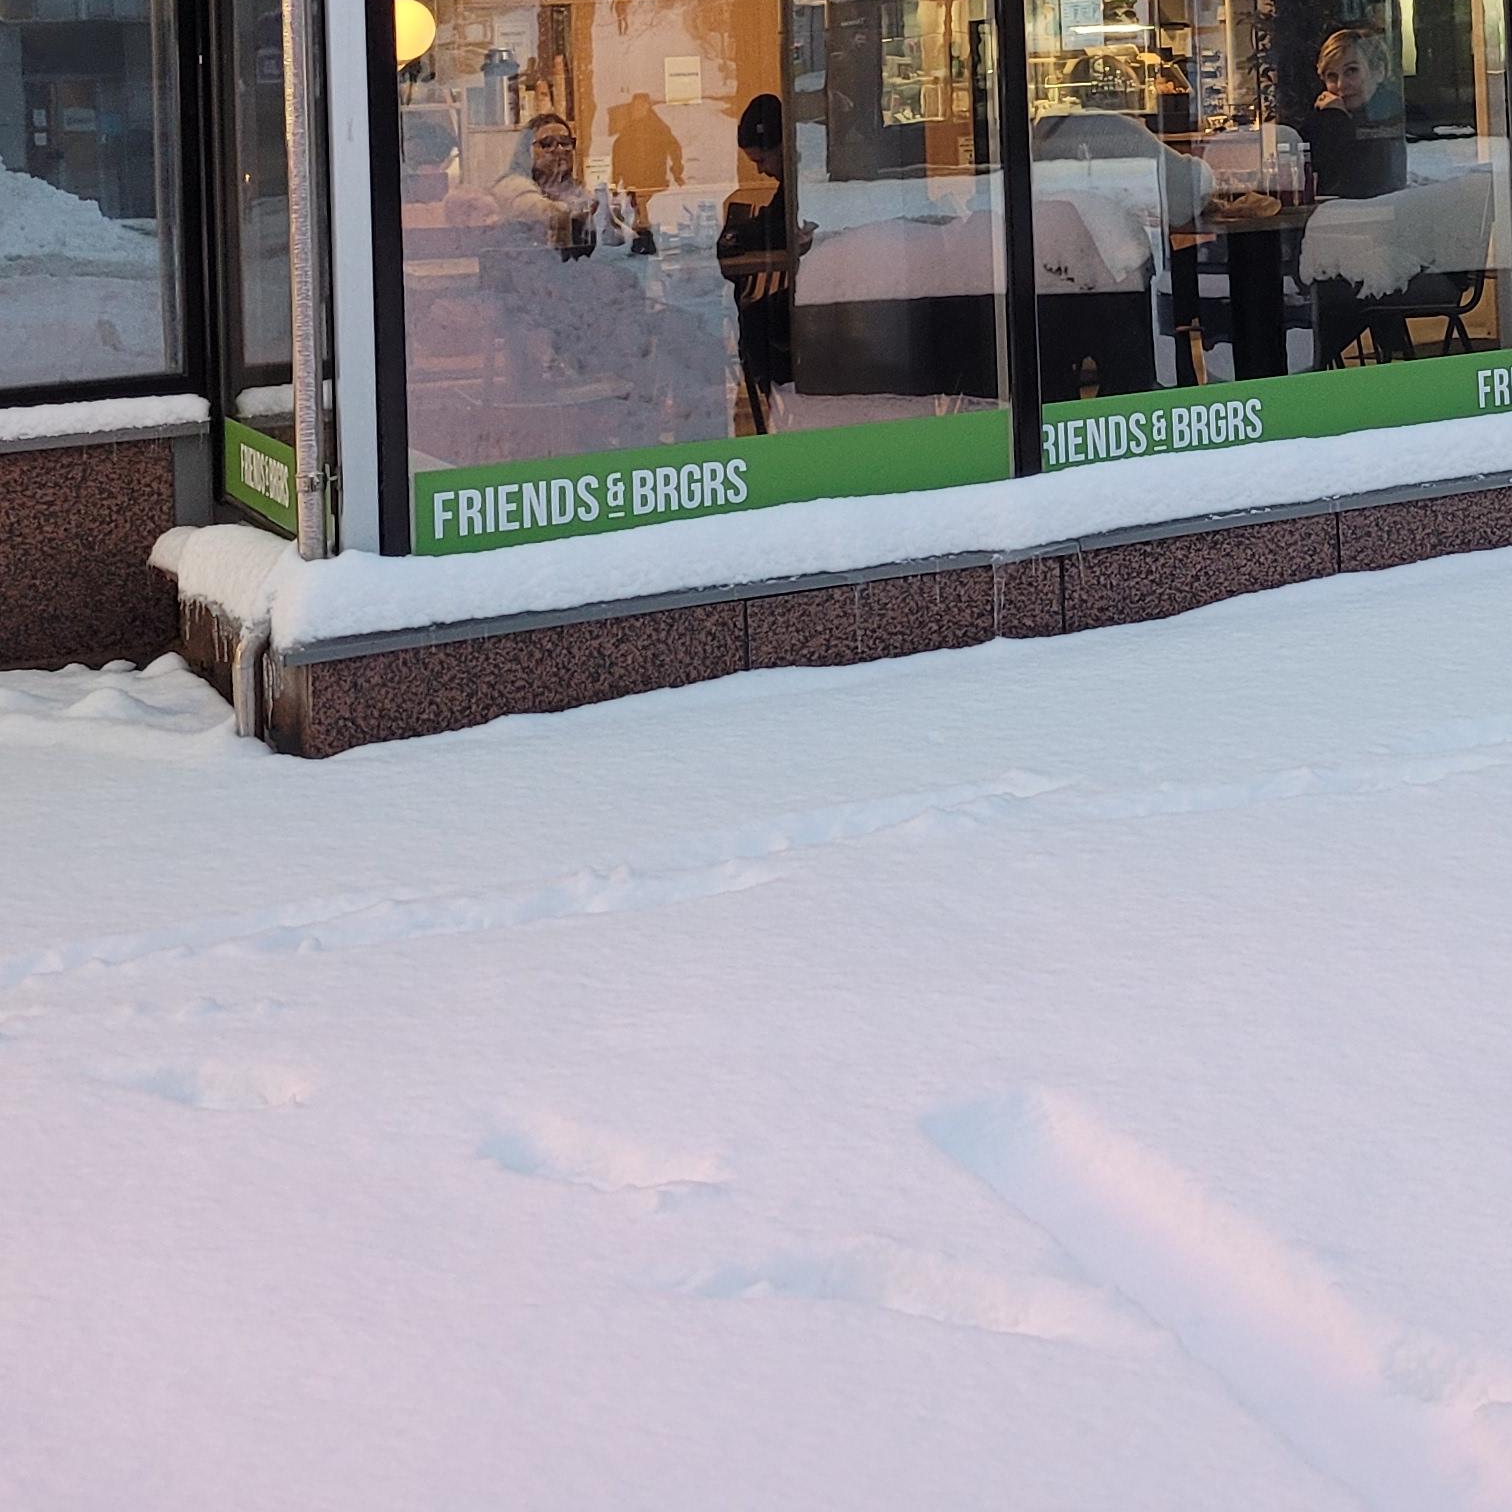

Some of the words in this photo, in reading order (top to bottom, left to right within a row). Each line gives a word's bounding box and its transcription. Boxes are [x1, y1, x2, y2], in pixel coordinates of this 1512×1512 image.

[1152, 410, 1167, 451] &
[1172, 398, 1263, 449] BRGRS
[434, 475, 600, 539] FRIENDS
[606, 472, 625, 518] &
[632, 458, 747, 515] BRGRS
